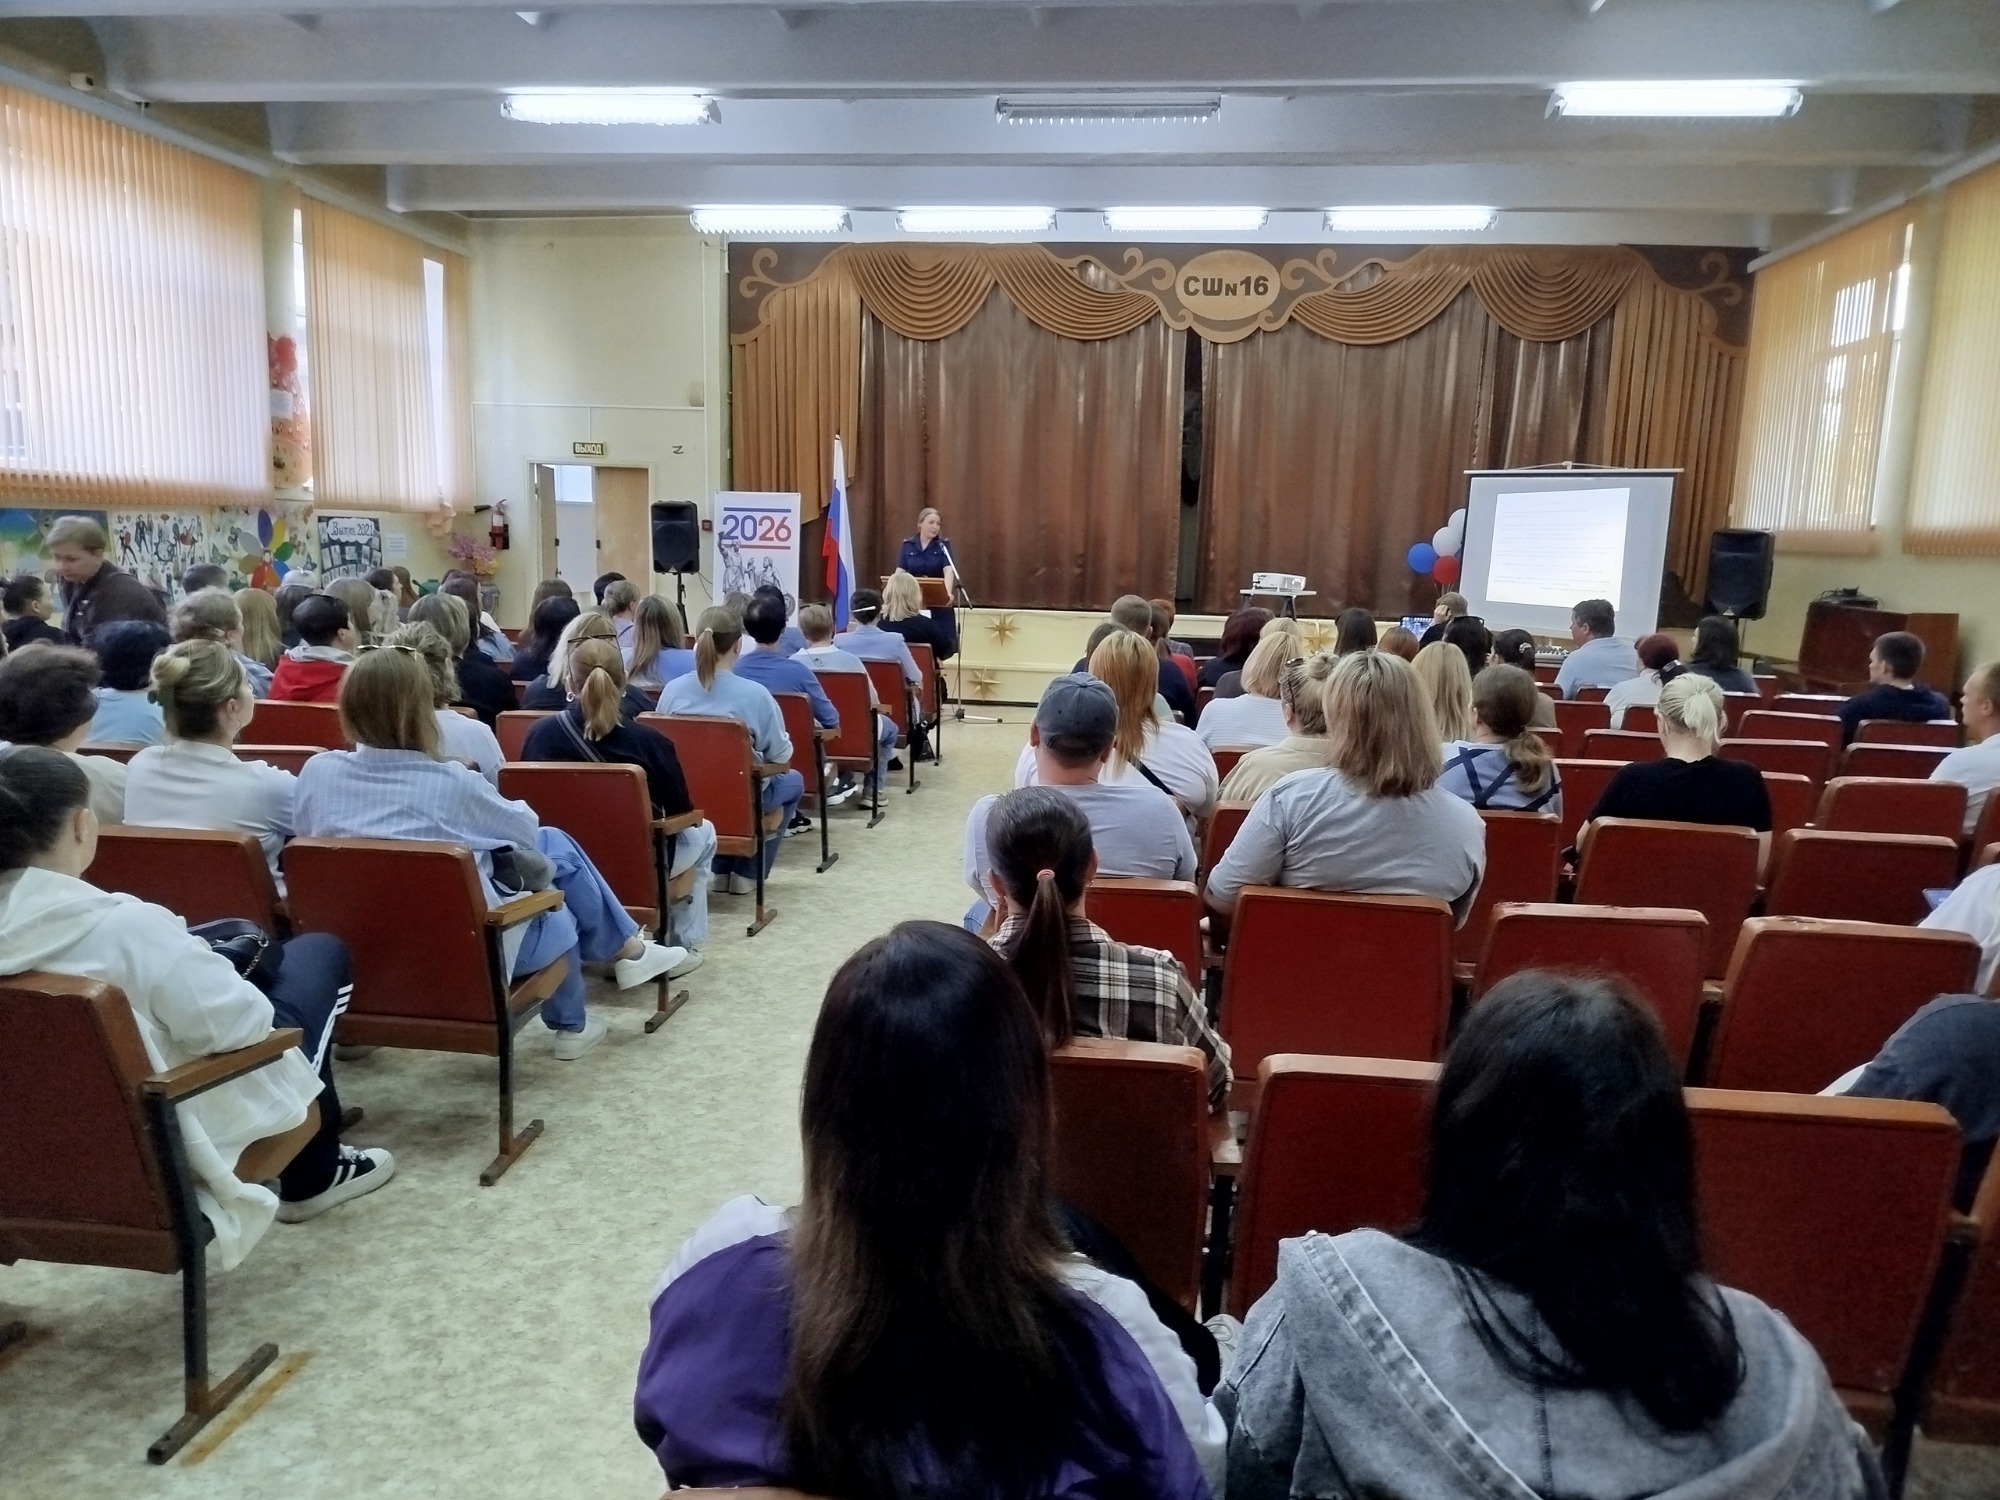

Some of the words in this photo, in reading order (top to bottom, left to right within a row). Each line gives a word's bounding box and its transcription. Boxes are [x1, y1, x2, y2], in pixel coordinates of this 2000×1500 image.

[575, 443, 602, 455] ВЫХОД
[357, 523, 373, 536] 2021
[722, 514, 792, 542] 2026
